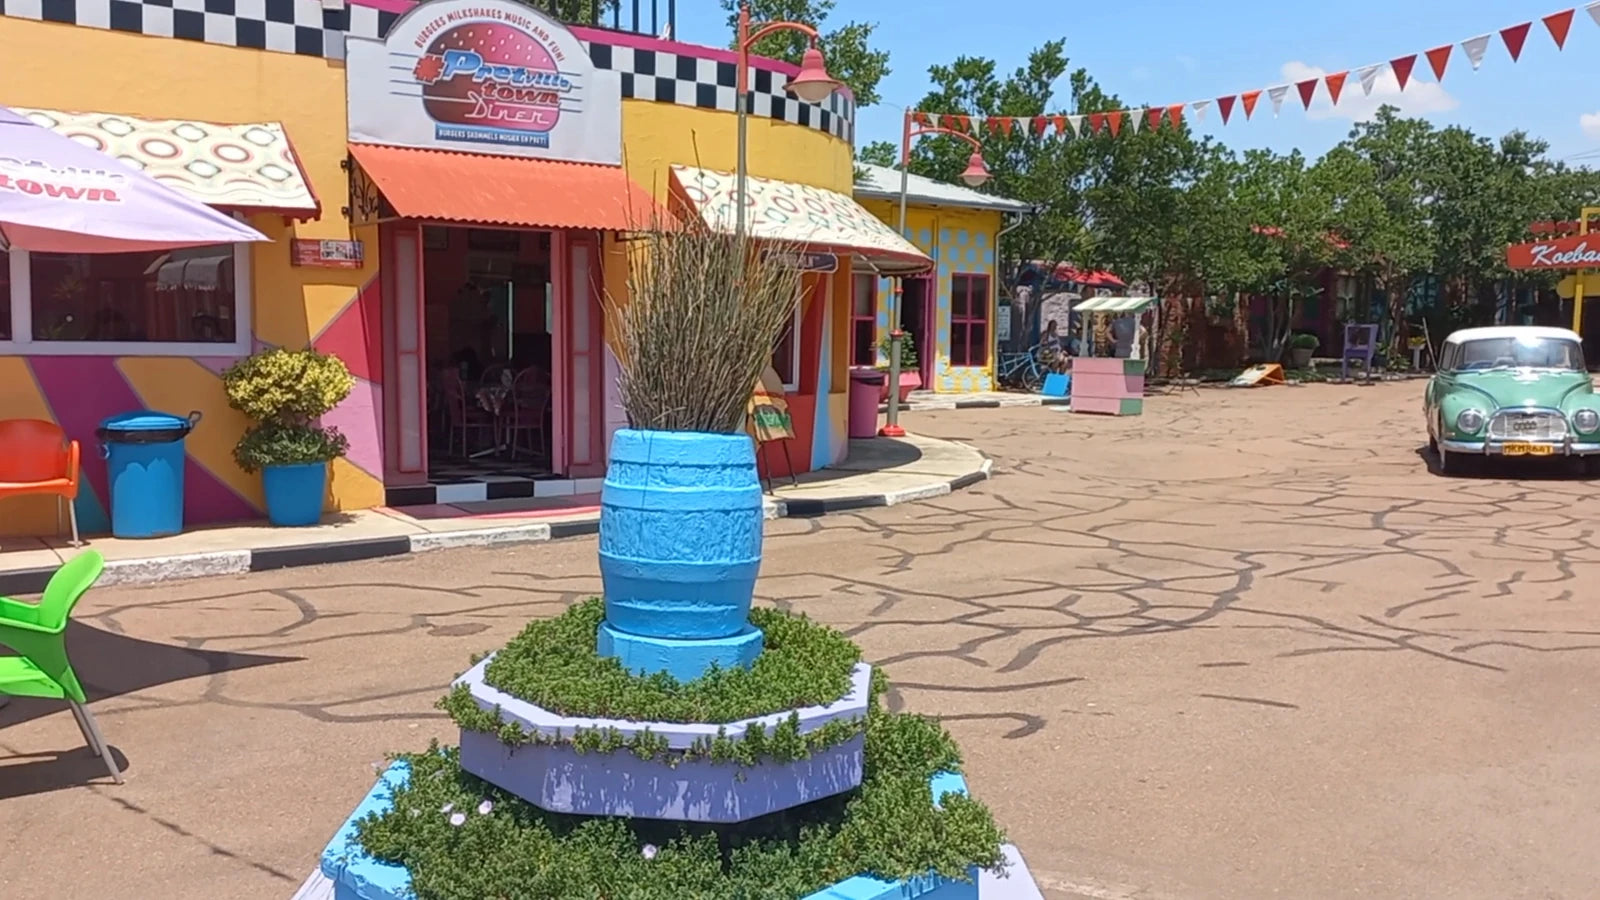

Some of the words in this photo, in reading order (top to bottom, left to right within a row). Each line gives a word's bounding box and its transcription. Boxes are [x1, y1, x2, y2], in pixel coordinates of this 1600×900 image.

[414, 17, 446, 48] BURGERS
[447, 8, 502, 22] MILKSHAKES
[505, 12, 531, 29] MUSIC
[532, 26, 549, 44] AND
[547, 39, 565, 62] FUN!
[481, 82, 560, 106] town
[439, 129, 465, 138] BURGERS
